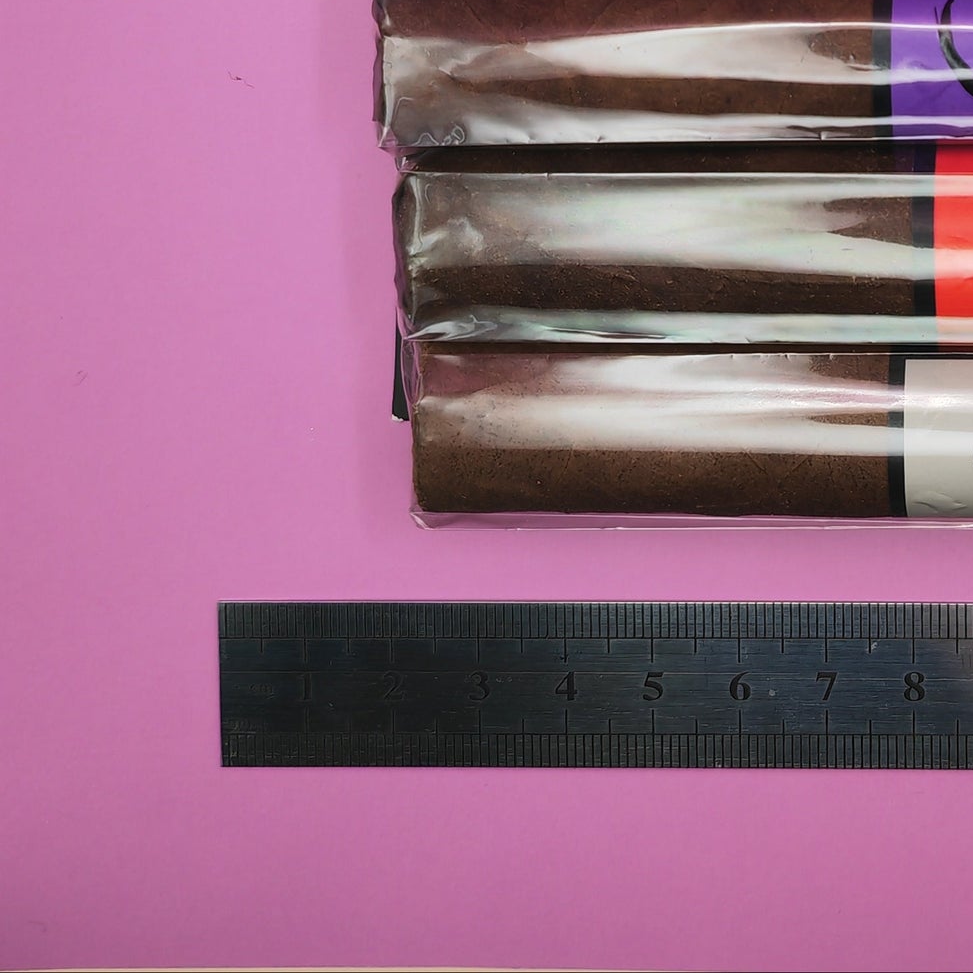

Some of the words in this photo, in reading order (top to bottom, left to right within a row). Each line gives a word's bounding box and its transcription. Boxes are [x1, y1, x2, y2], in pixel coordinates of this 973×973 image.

[297, 673, 313, 701] 1
[384, 670, 406, 701] 2
[468, 671, 490, 701] 3
[555, 671, 578, 701] 4
[642, 672, 664, 701] 5
[729, 671, 751, 701] 6
[815, 672, 838, 701] 7
[903, 671, 925, 701] 8
